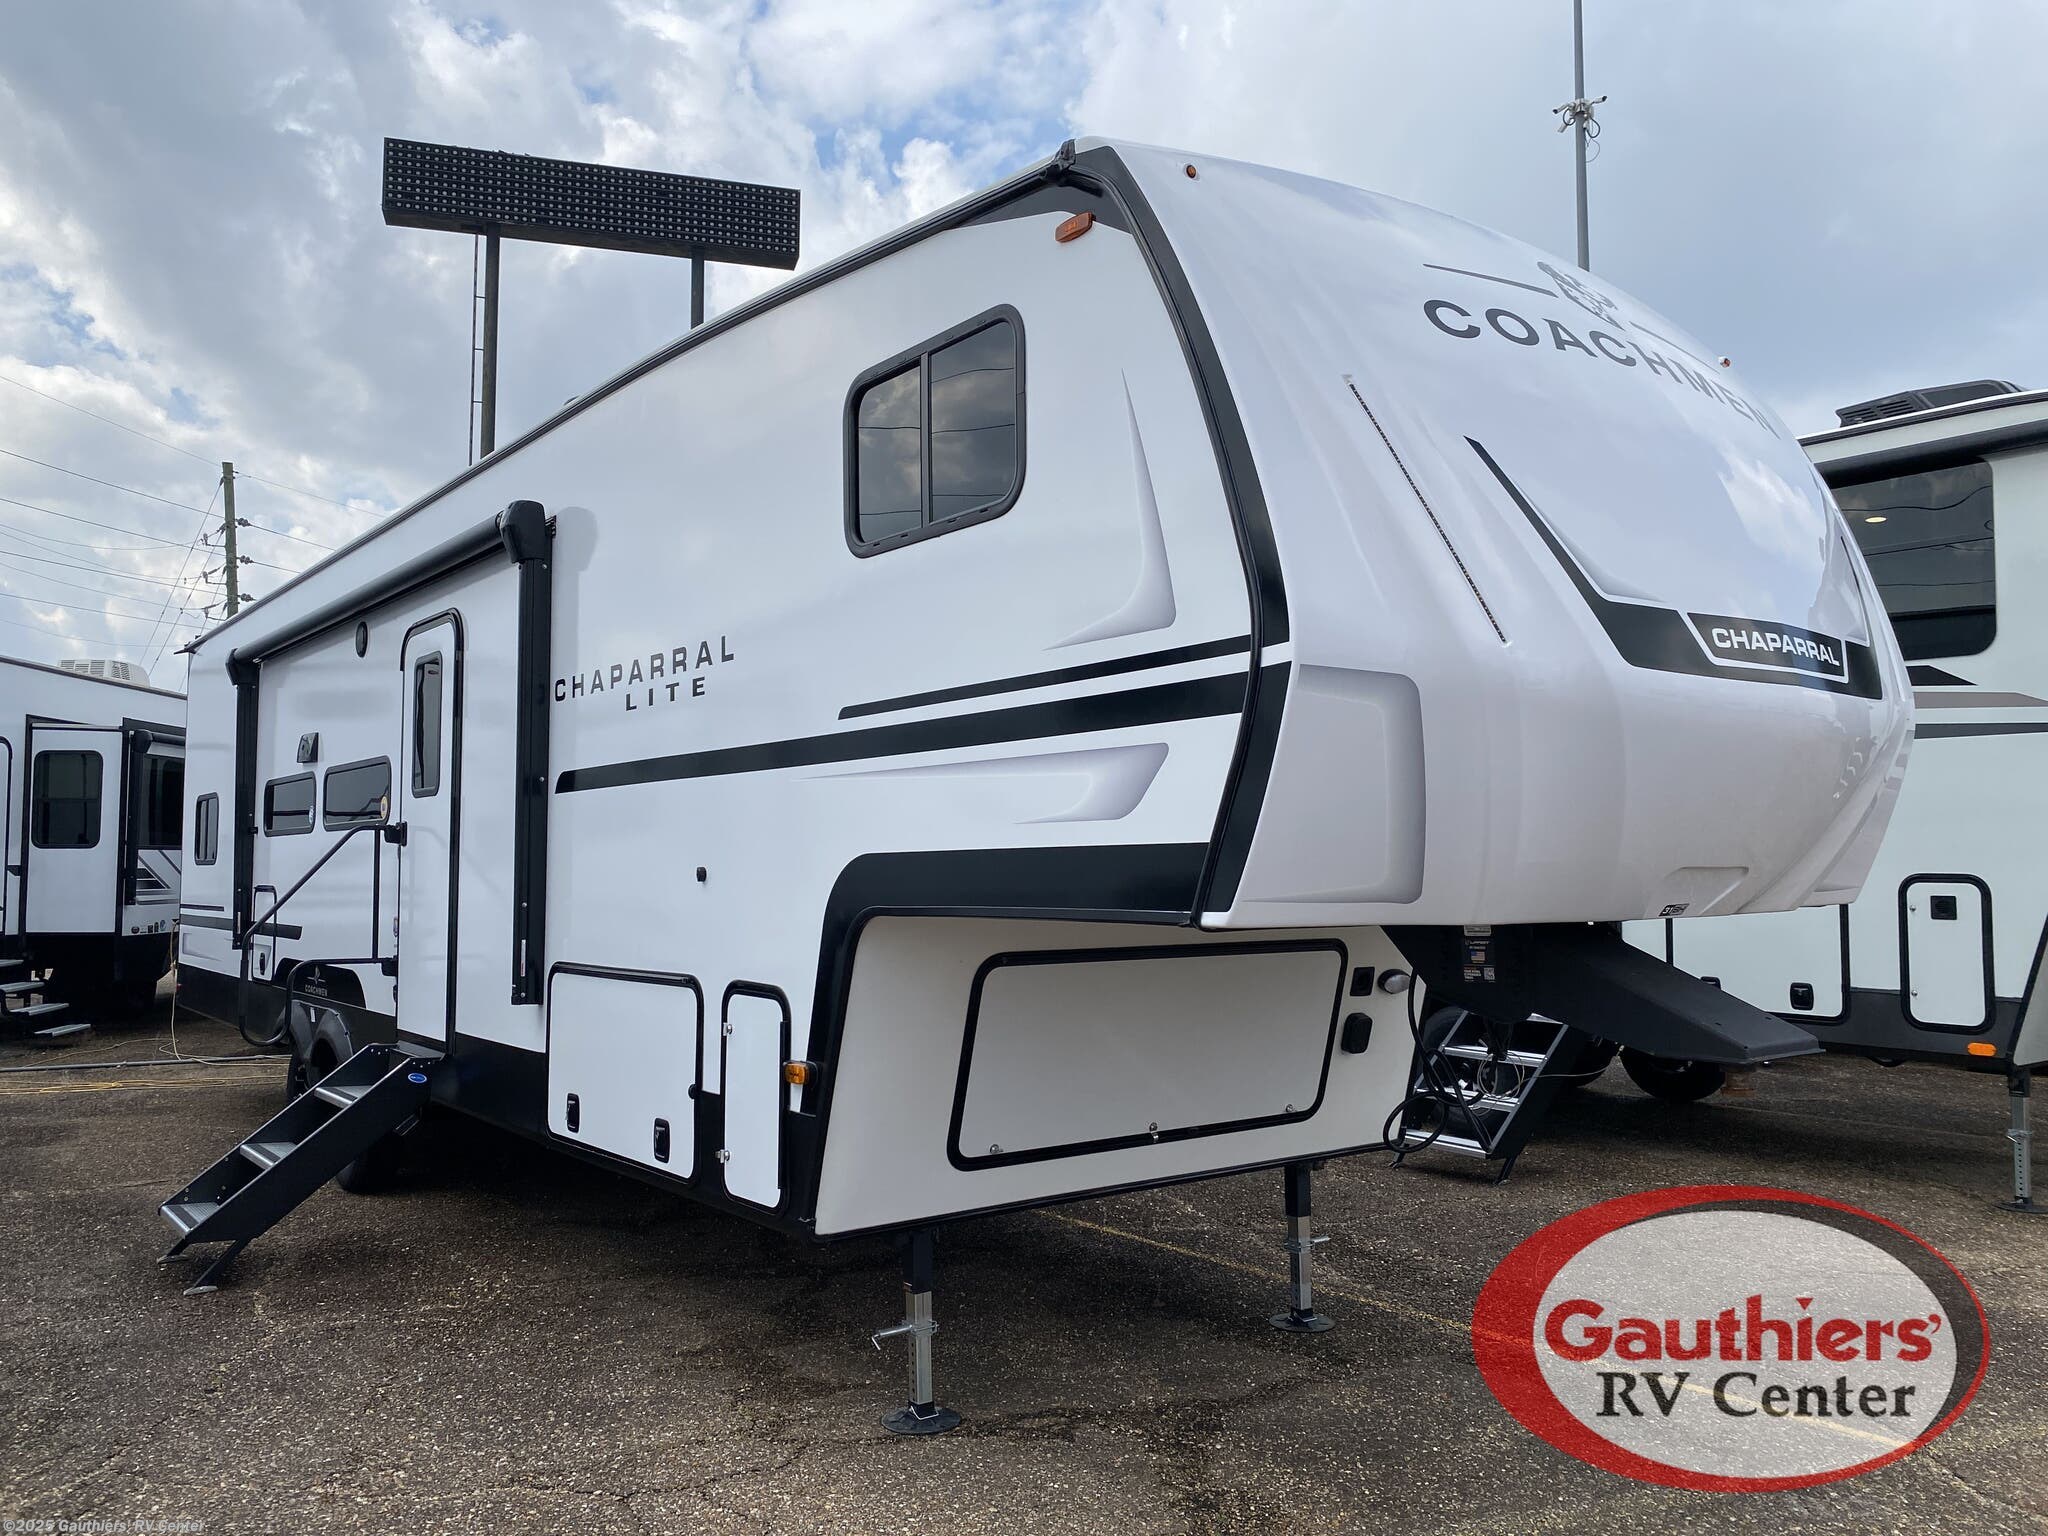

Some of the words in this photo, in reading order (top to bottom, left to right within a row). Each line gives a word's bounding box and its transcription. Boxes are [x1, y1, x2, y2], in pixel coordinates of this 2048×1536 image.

[1423, 299, 1781, 440] COACHMEN
[554, 635, 735, 702] CHAPARRAL
[1711, 627, 1841, 667] CHAPARRAL
[625, 676, 705, 711] LITE
